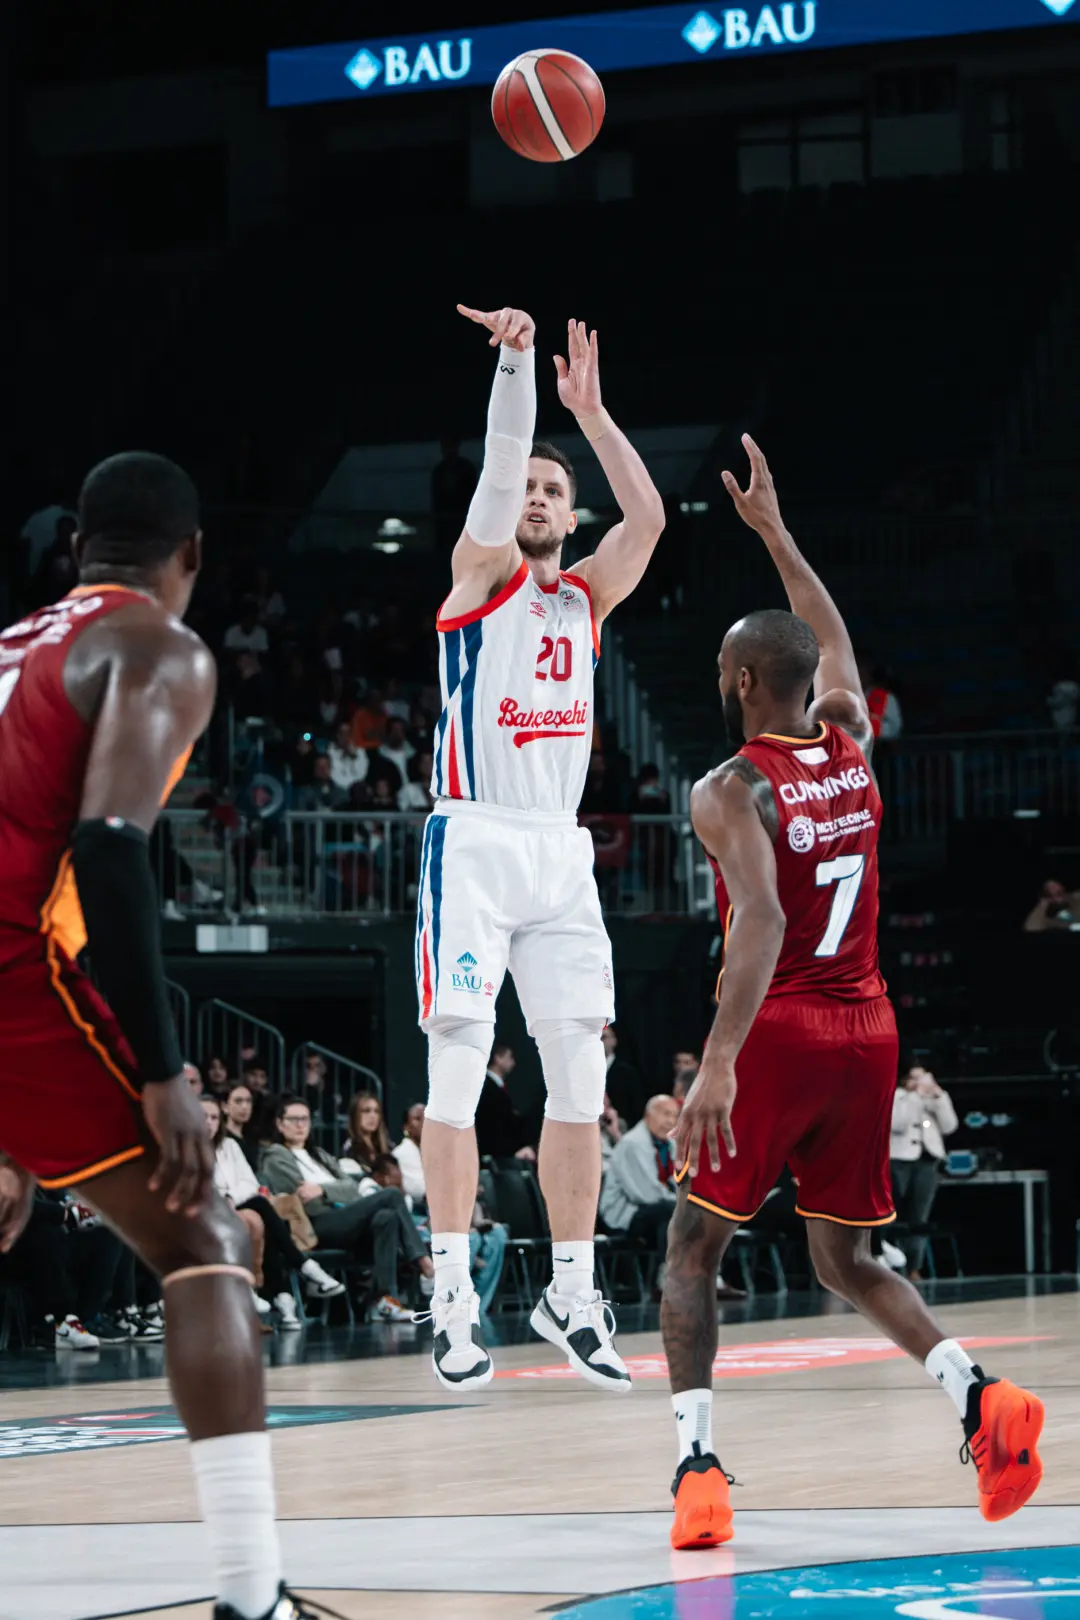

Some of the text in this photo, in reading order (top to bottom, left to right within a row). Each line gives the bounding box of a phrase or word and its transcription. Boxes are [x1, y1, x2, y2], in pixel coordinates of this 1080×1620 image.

[721, 0, 817, 49] BAU
[383, 38, 472, 86] BAU
[535, 635, 573, 682] 20
[779, 765, 870, 805] CUMMINGS
[814, 853, 866, 958] 7
[452, 973, 483, 990] BAU
